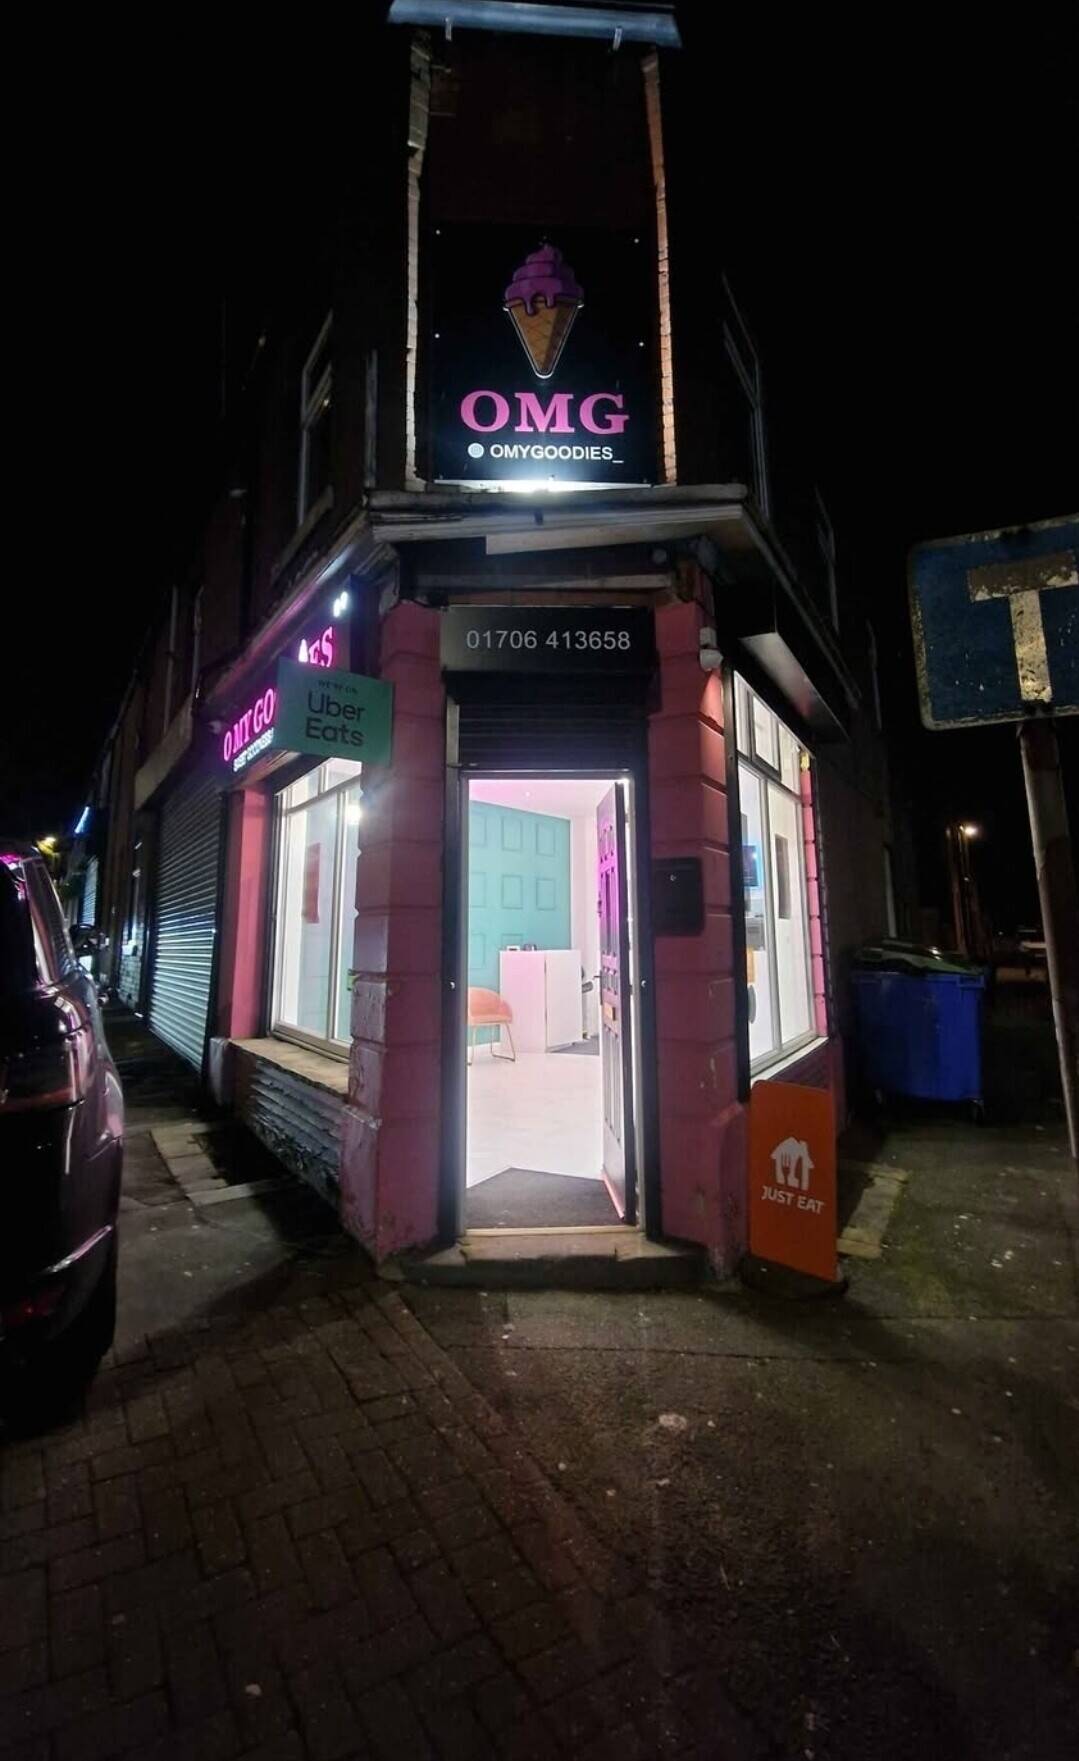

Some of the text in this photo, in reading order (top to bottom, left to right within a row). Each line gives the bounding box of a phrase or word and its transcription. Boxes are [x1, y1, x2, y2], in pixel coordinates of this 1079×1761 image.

[460, 390, 630, 434] OMG
[489, 444, 624, 463] OMYGOODIES_
[466, 630, 631, 650] 01706 413658
[308, 690, 365, 721] Uber
[305, 716, 364, 747] Eats
[761, 1185, 825, 1214] JUST EAT
